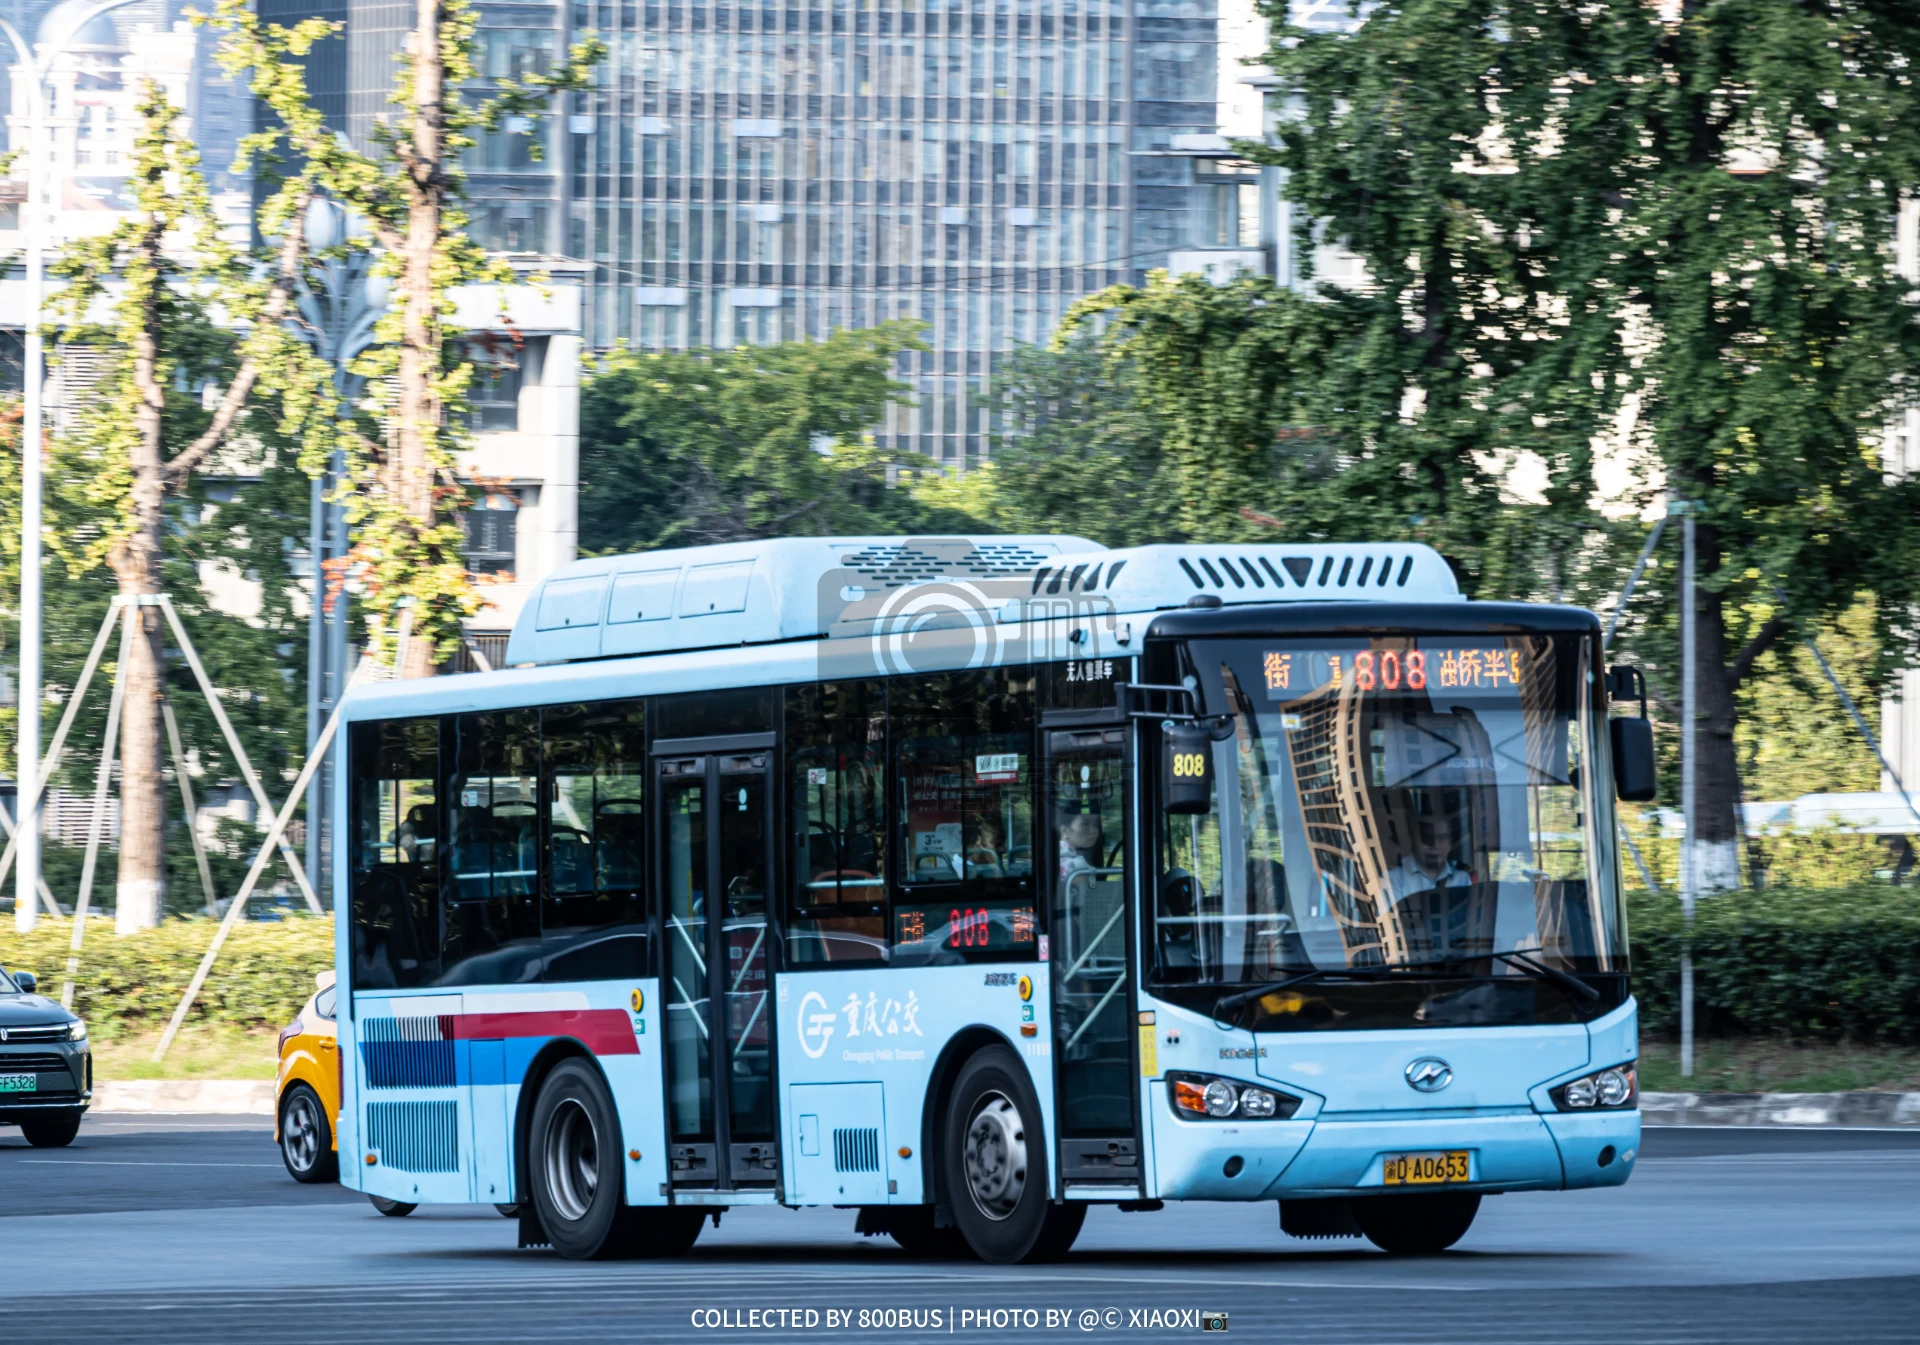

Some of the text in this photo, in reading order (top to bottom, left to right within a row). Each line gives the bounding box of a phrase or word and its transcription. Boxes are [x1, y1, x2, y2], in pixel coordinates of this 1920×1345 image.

[1354, 650, 1427, 691] 808
[1173, 753, 1205, 777] 808
[949, 907, 989, 947] 808
[841, 989, 924, 1038] 重庆公交
